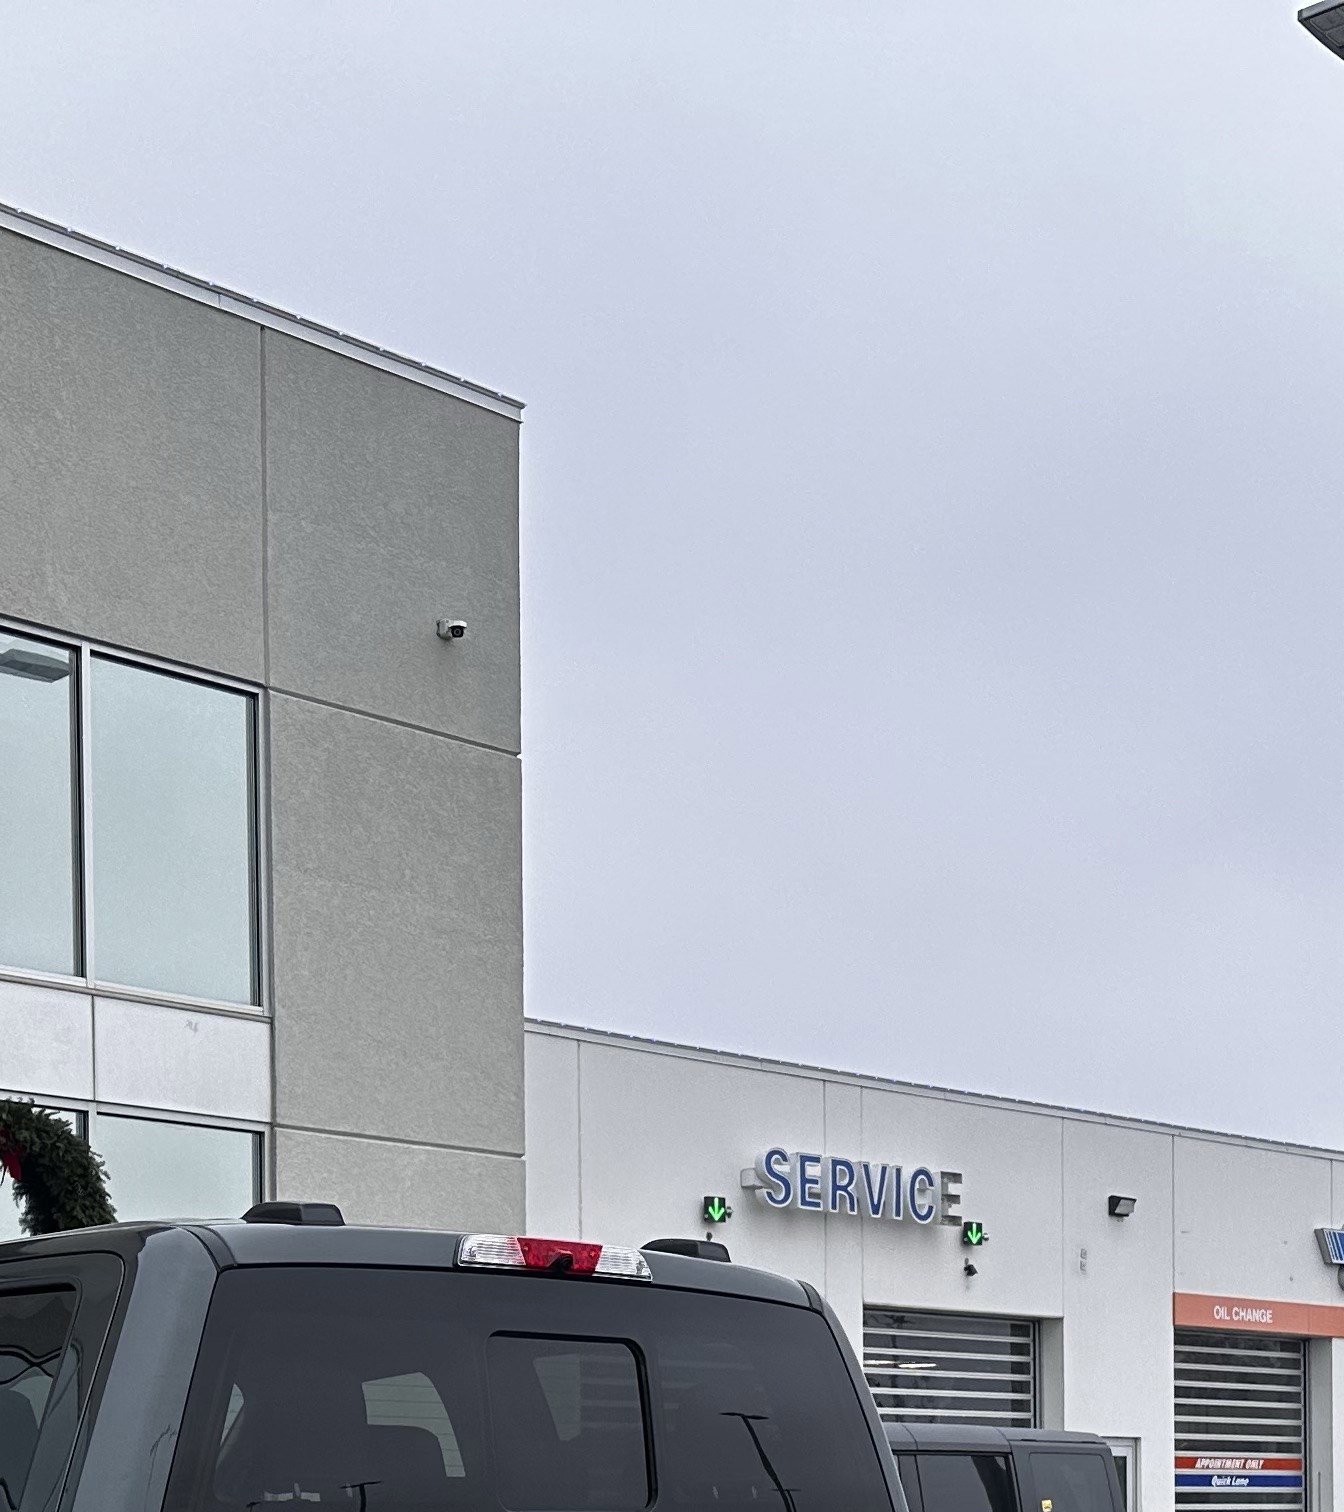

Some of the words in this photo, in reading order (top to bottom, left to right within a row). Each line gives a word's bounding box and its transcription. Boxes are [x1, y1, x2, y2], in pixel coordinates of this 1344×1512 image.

[761, 1147, 963, 1226] SERVICE
[1213, 1305, 1231, 1321] OIL
[1232, 1307, 1273, 1324] CHANGE
[1195, 1458, 1245, 1469] APPOINTMENT
[1246, 1459, 1264, 1470] ONLY
